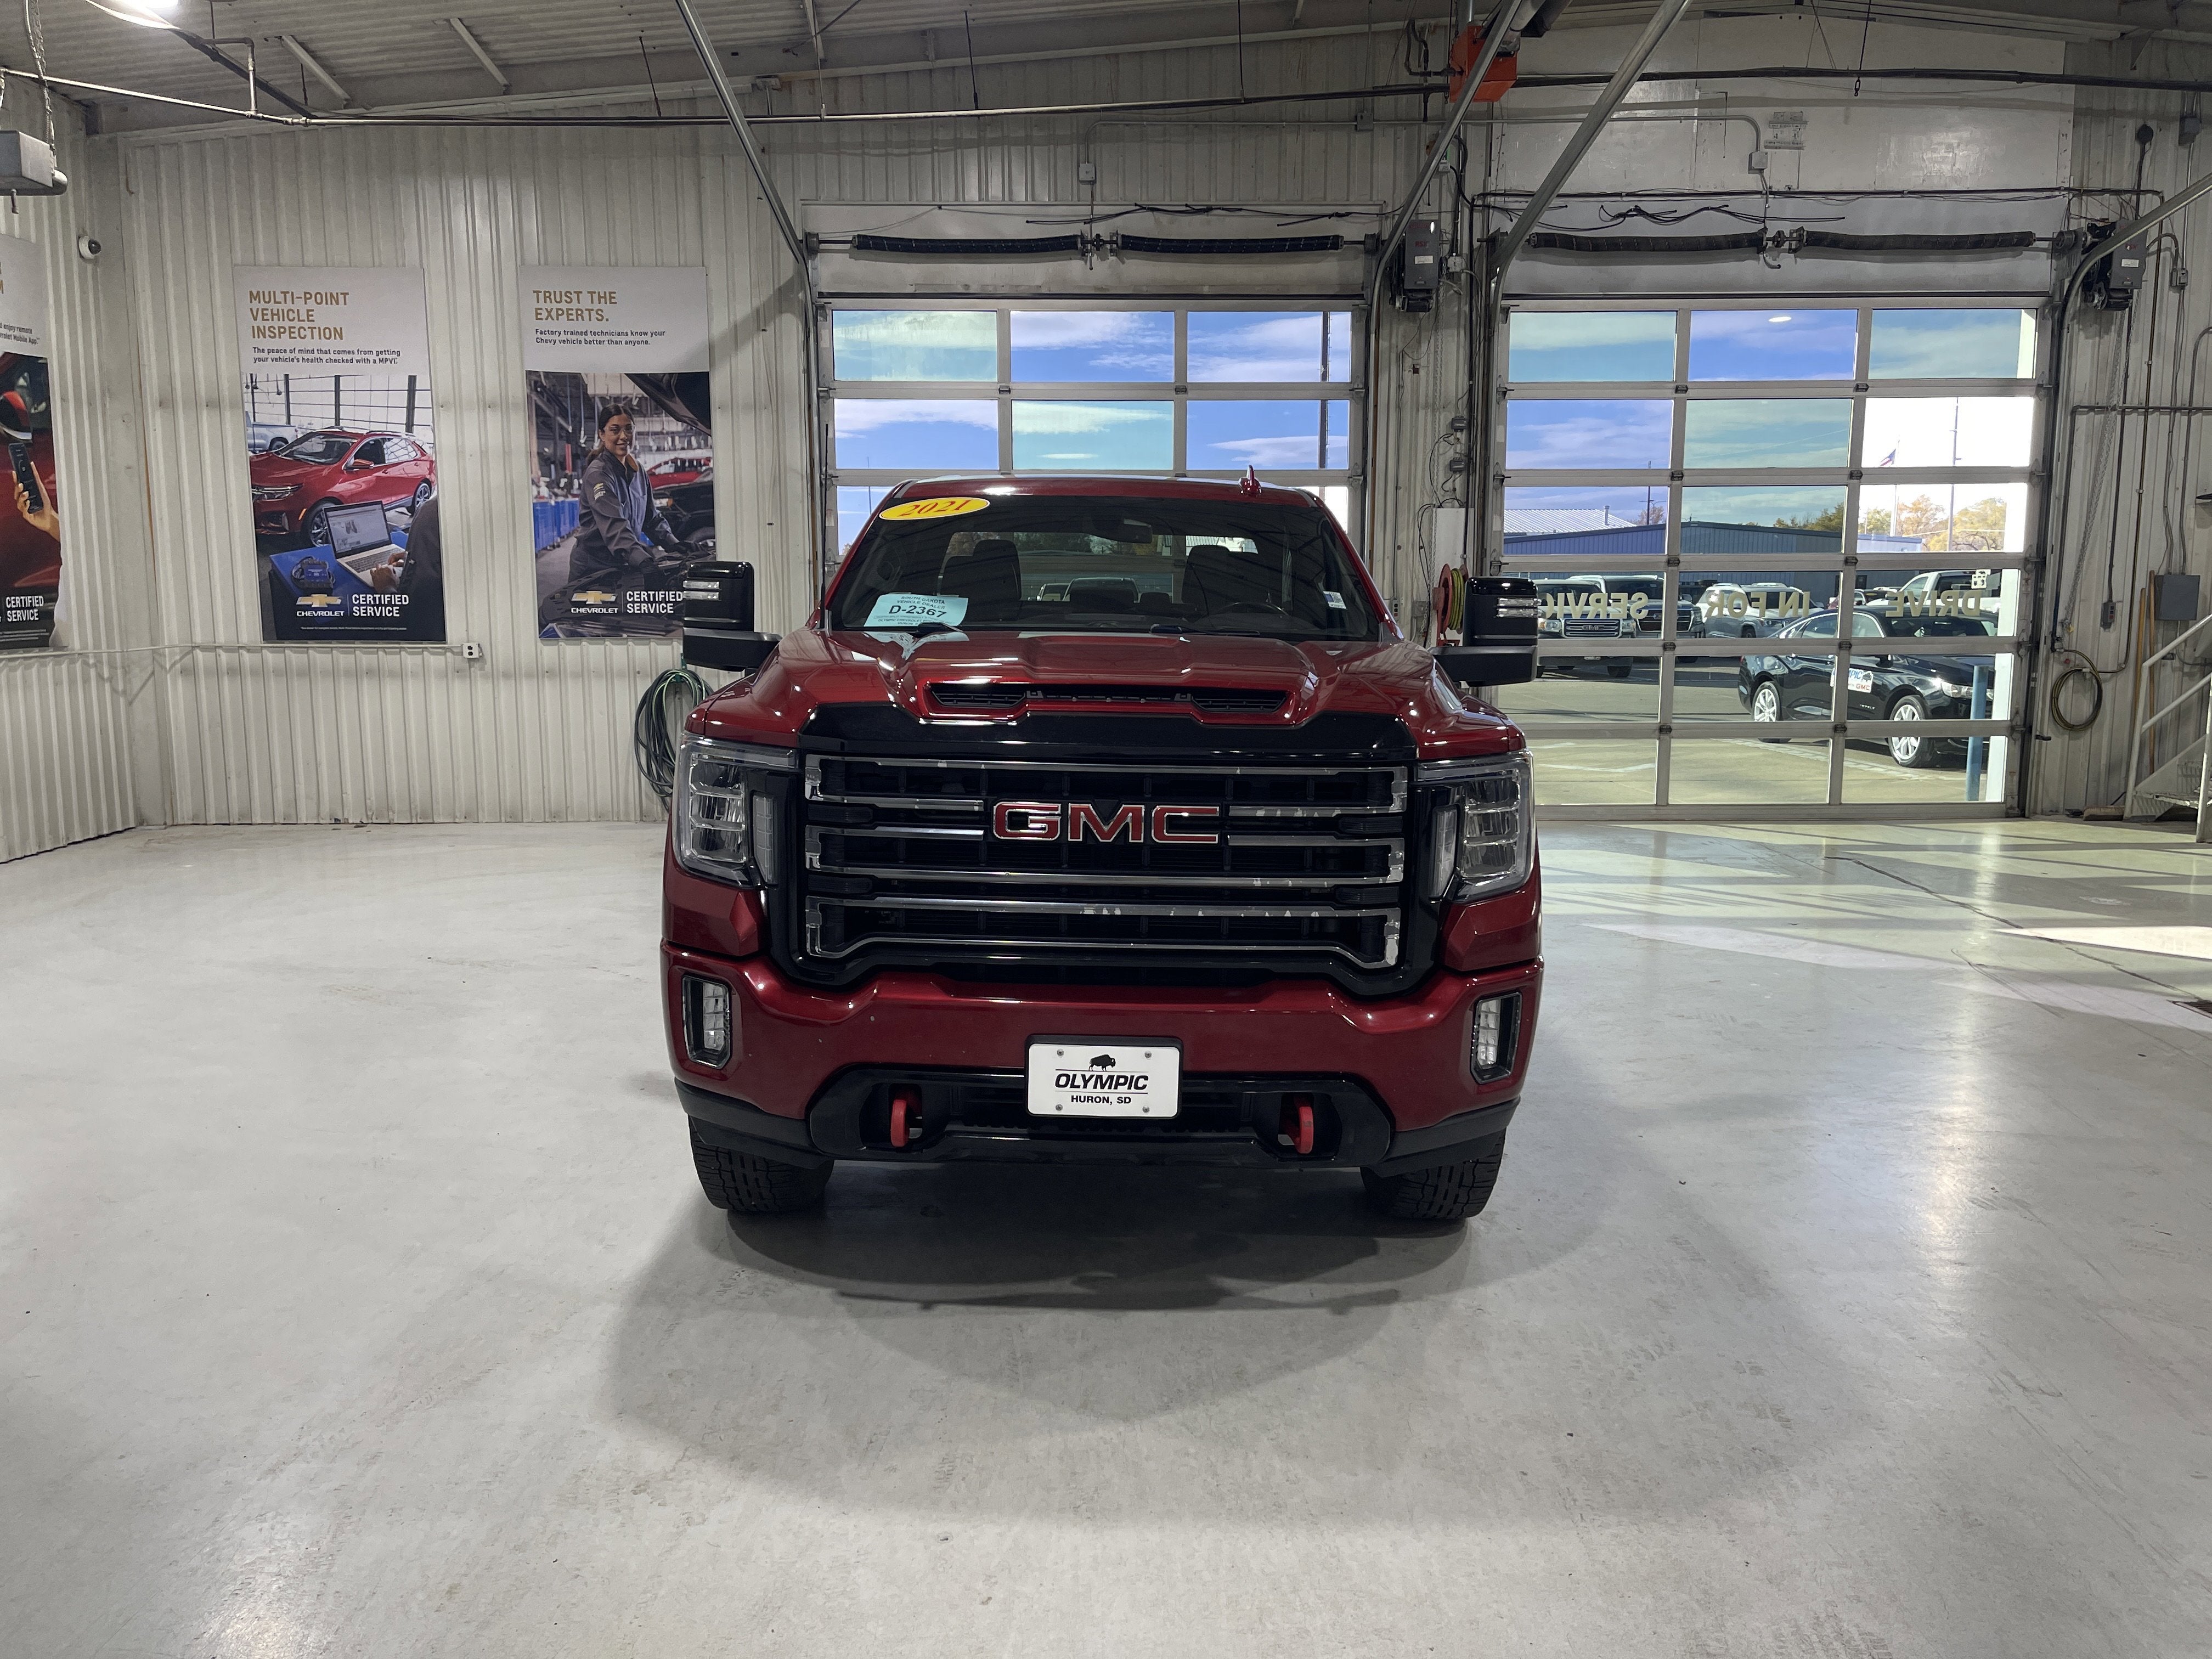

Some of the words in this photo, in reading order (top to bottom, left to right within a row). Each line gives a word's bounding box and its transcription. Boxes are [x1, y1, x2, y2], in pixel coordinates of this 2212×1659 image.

[249, 290, 349, 306] MULTI-POINT
[533, 290, 583, 304] TRUST
[587, 291, 617, 304] THE
[250, 308, 315, 323] VEHICLE
[534, 308, 610, 322] EXPERTS.
[251, 325, 343, 341] INSPECTION
[535, 329, 562, 337] Factory
[535, 337, 556, 346] Chevy
[896, 500, 972, 517] 2021
[5, 595, 44, 608] CERTIFIED
[352, 594, 409, 605] CERTIFIED
[626, 591, 683, 601] CERTIFIED
[7, 608, 40, 622] SERVICE
[353, 606, 400, 617] SERVICE
[627, 603, 674, 614] SERVICE
[889, 605, 947, 618] D-2367
[993, 802, 1221, 844] GMC
[1054, 1073, 1149, 1091] OLYMPIC
[1070, 1095, 1113, 1105] HURON,
